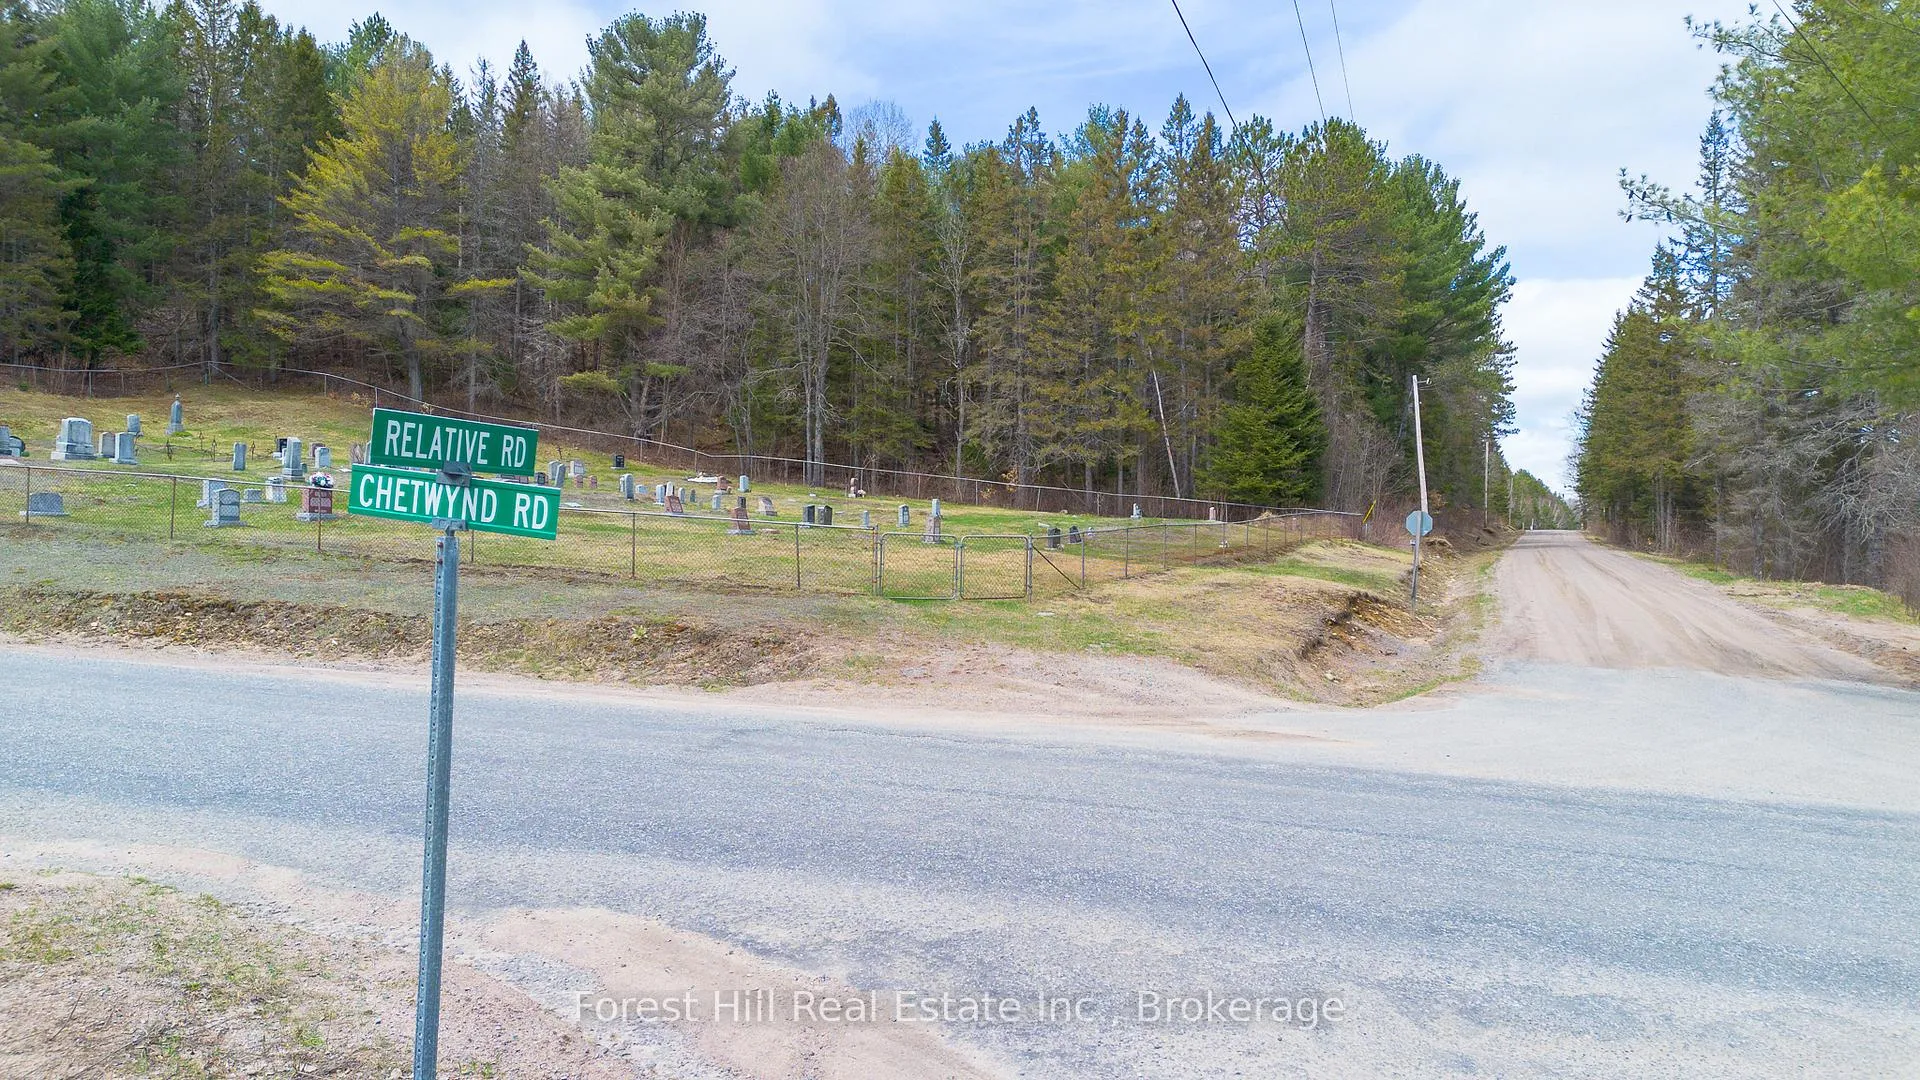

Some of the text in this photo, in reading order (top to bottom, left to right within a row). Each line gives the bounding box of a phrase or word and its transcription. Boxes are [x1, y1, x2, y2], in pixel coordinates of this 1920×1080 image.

[384, 419, 526, 468] RELATIVE RD
[359, 473, 498, 524] CHETWYND
[513, 493, 549, 530] RD
